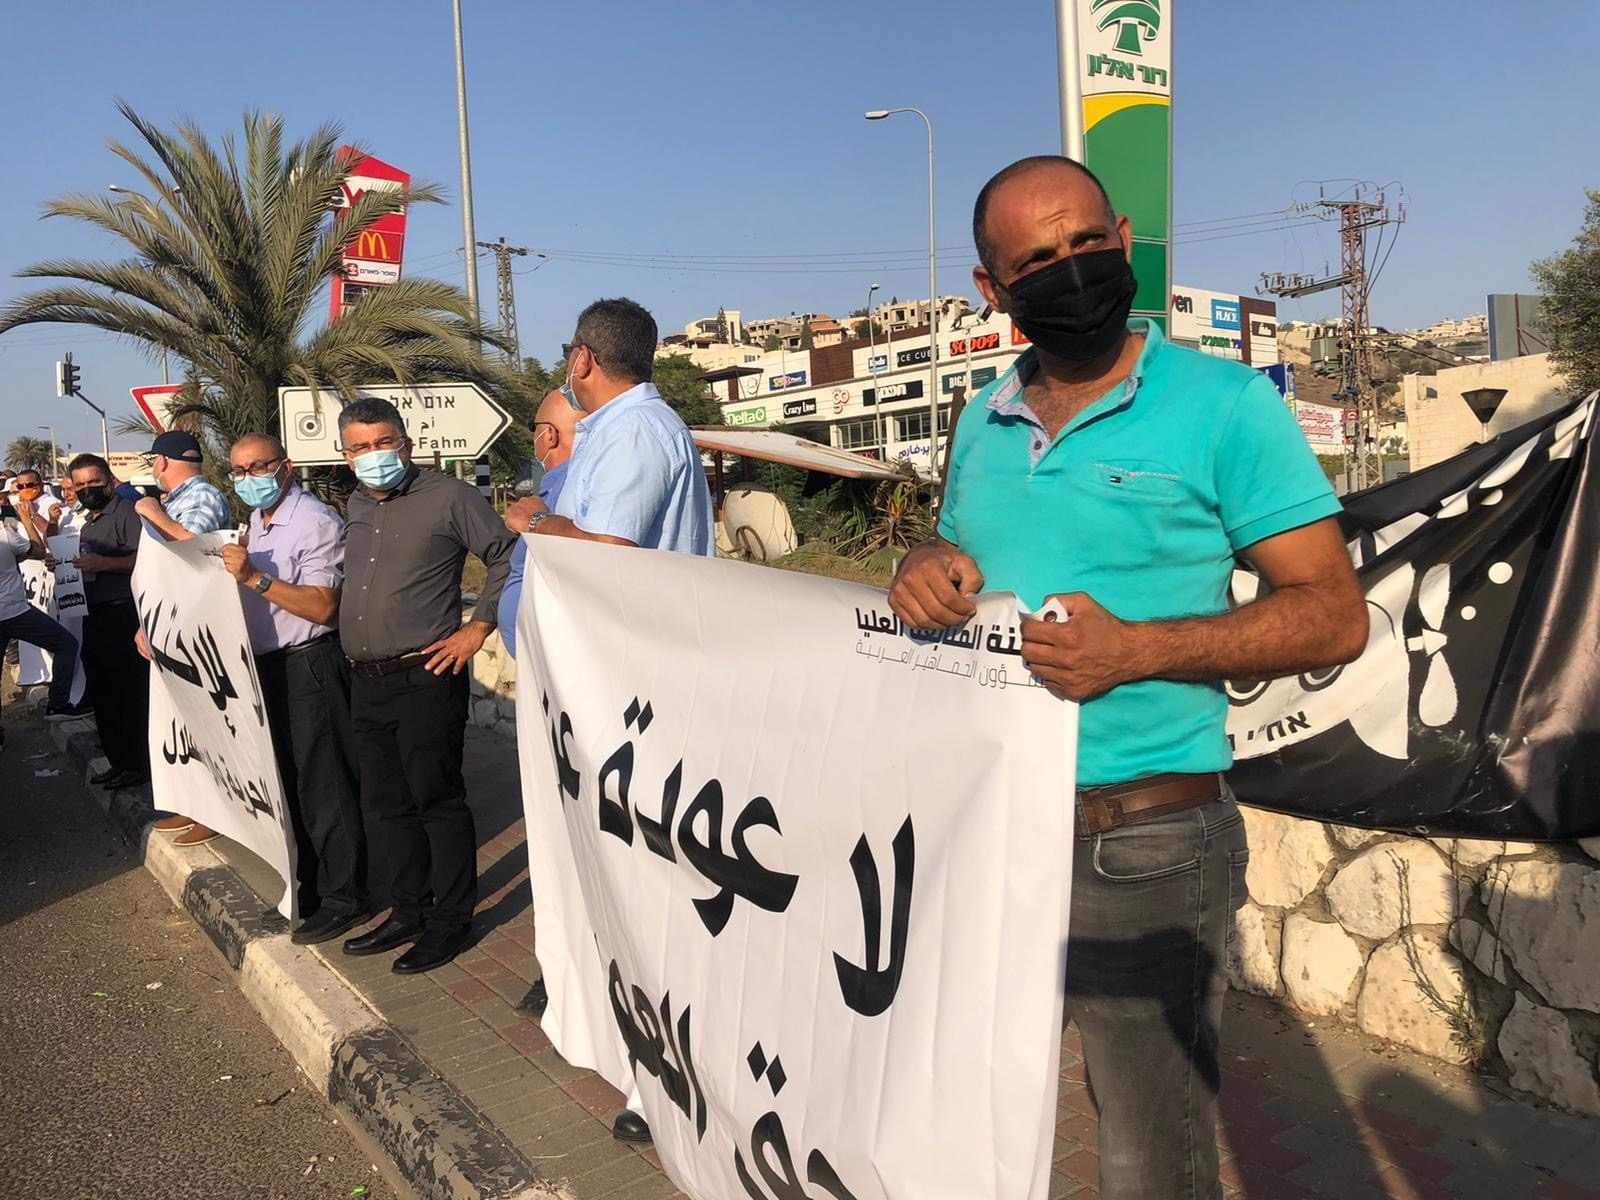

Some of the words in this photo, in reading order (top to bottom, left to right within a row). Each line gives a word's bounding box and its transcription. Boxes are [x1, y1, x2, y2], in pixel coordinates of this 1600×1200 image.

[1087, 53, 1135, 81] אלון
[424, 395, 456, 409] אום
[783, 403, 803, 417] Crazy
[727, 409, 755, 426] Delta
[411, 436, 467, 450] -Fahm
[855, 607, 904, 638] العليا
[856, 638, 916, 665] العربية
[911, 652, 979, 680] الجماهير
[599, 695, 800, 938] عودة
[832, 813, 915, 1018] لا
